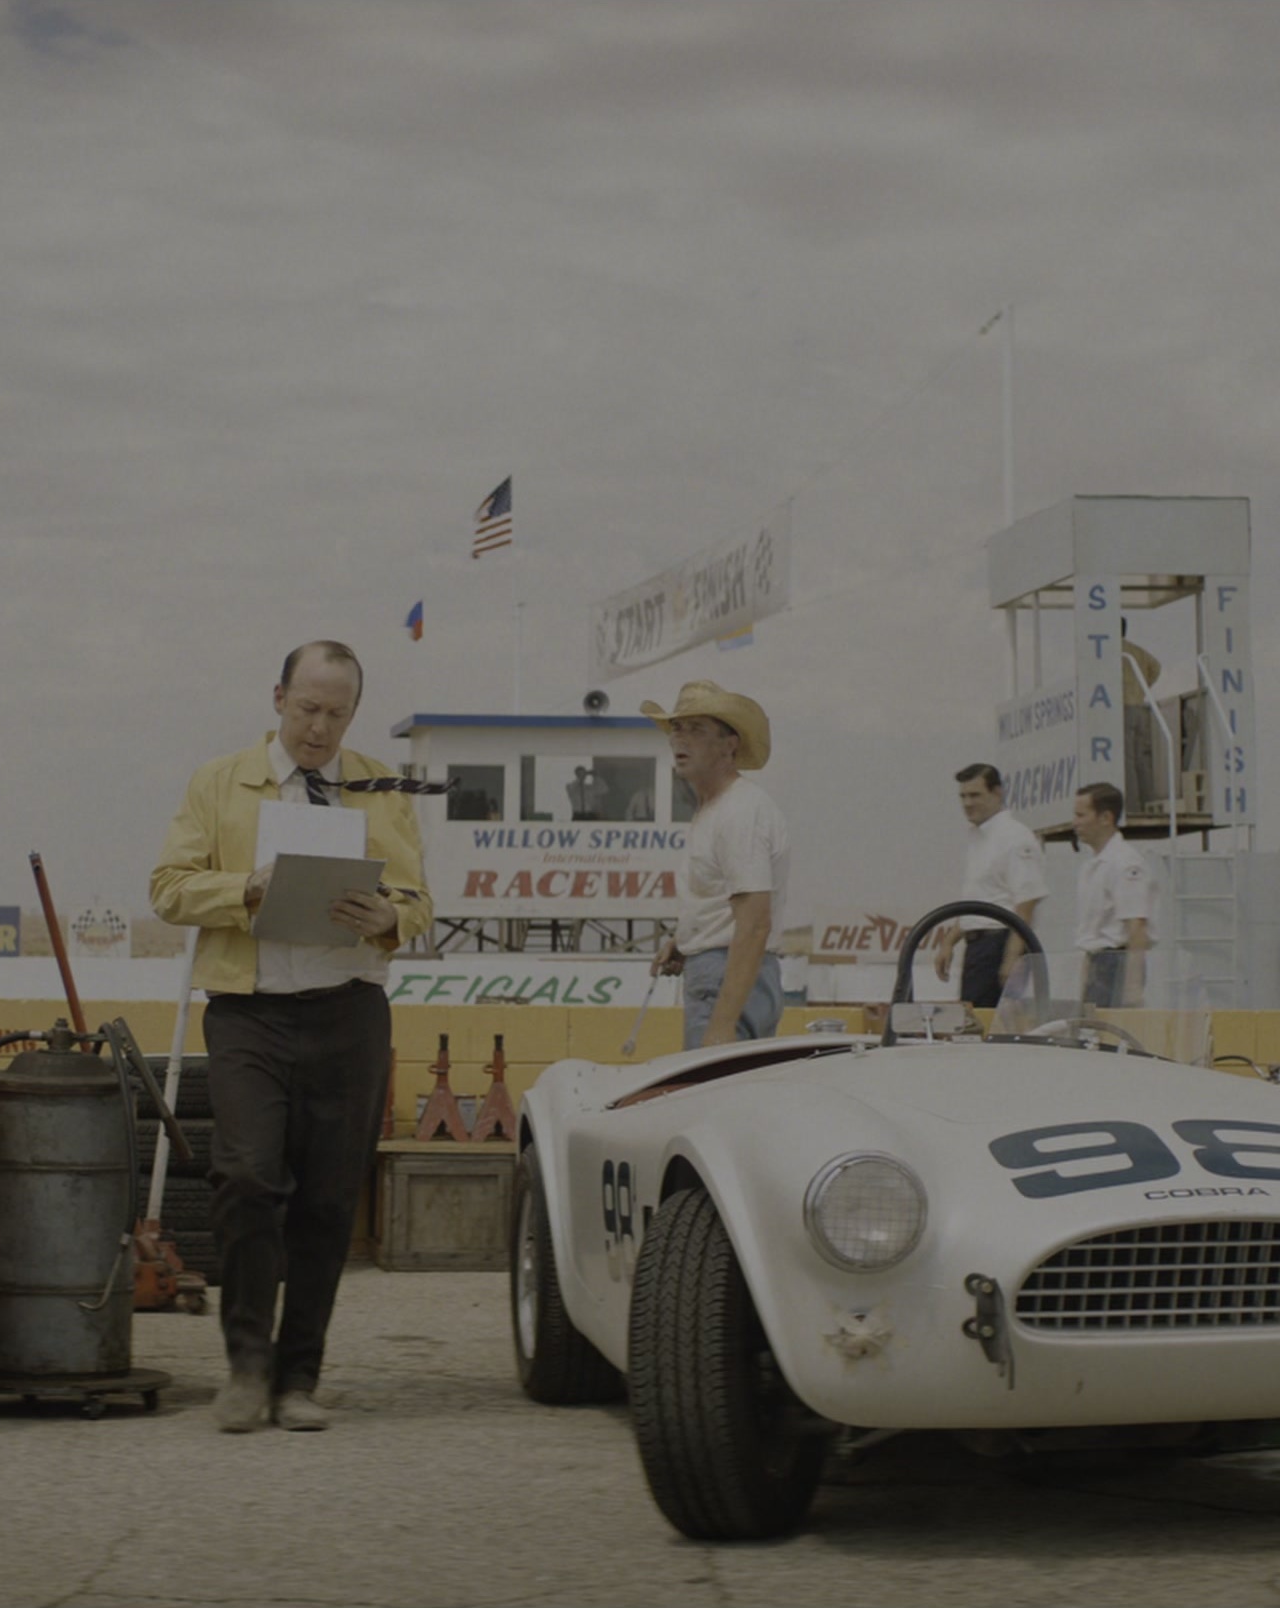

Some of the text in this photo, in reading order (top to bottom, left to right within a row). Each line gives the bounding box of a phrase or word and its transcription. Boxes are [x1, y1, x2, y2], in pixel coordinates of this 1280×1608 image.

[609, 590, 666, 665] START
[472, 829, 580, 849] WILLOW
[542, 853, 632, 865] International
[602, 1159, 634, 1244] 98
[1143, 1185, 1272, 1201] COBRA
